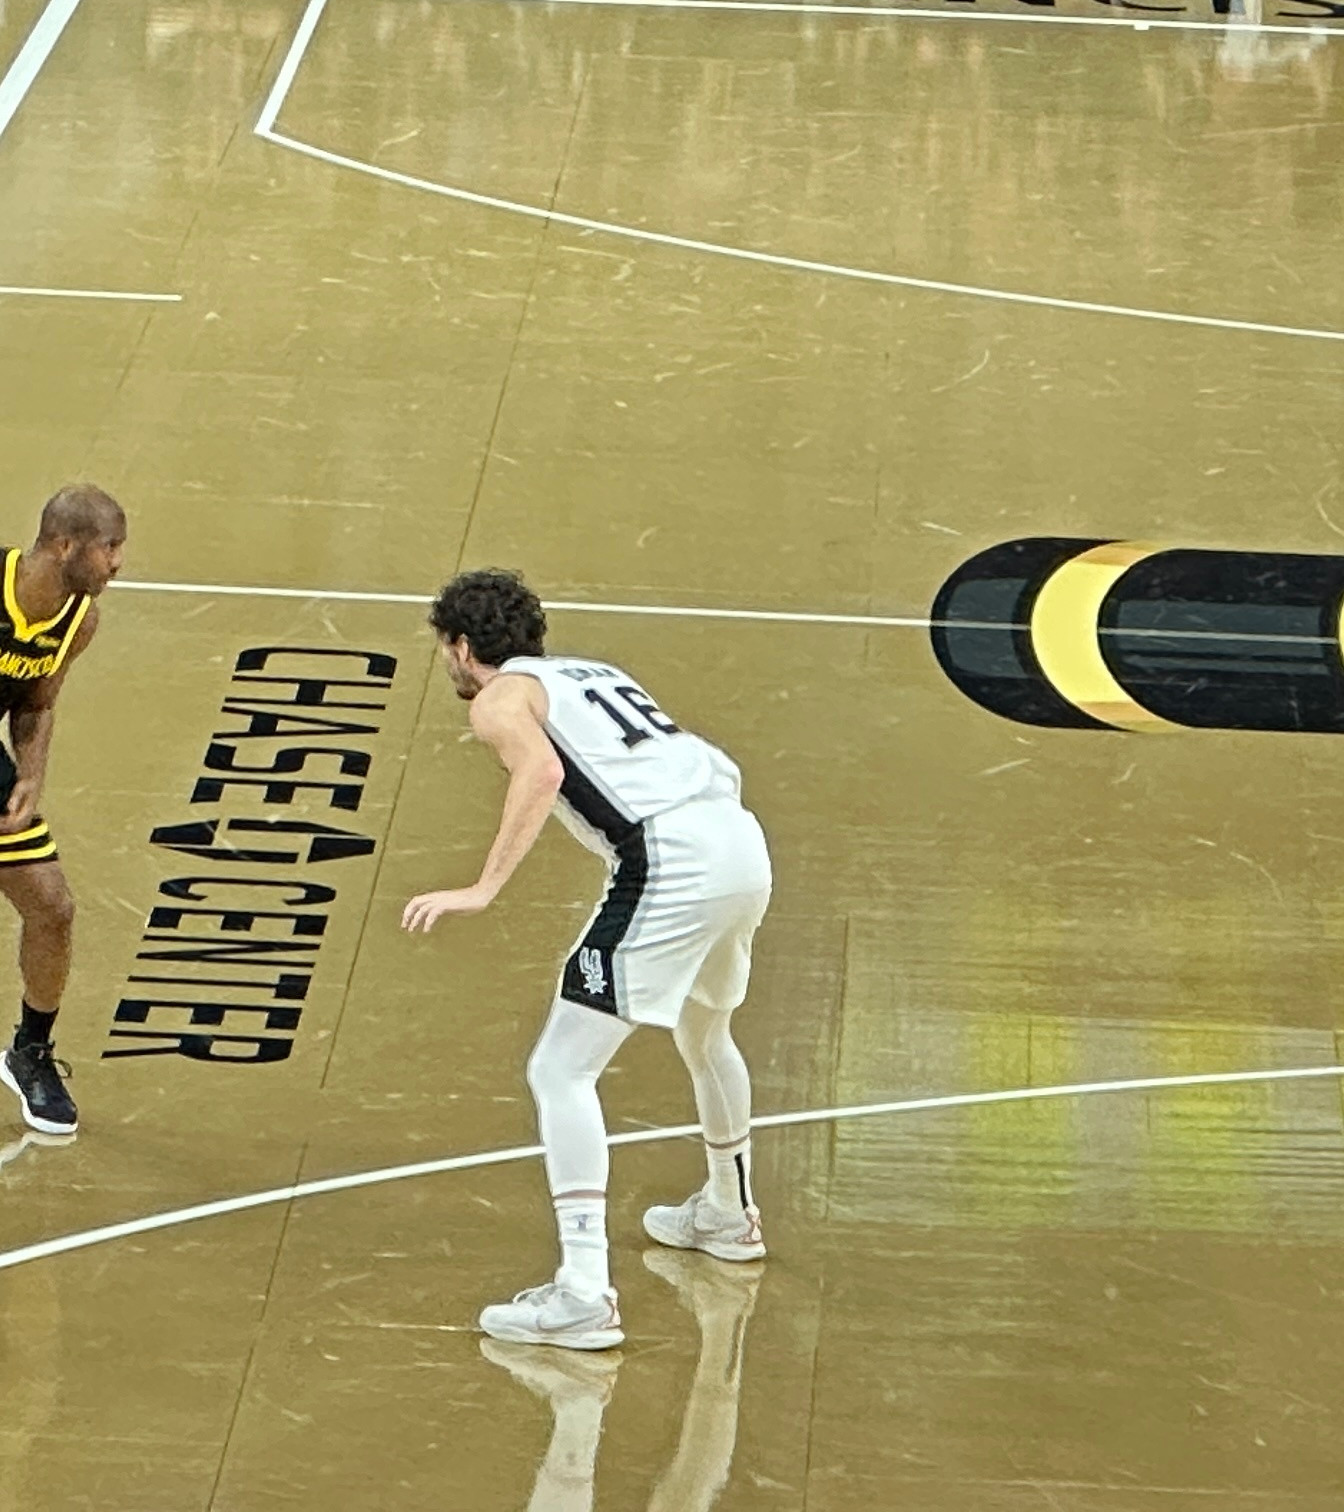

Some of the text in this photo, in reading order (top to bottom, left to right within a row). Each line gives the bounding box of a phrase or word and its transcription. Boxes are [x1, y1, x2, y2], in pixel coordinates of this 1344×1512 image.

[189, 645, 398, 812] CHASE
[584, 685, 682, 750] 16
[100, 875, 338, 1065] CENTER
